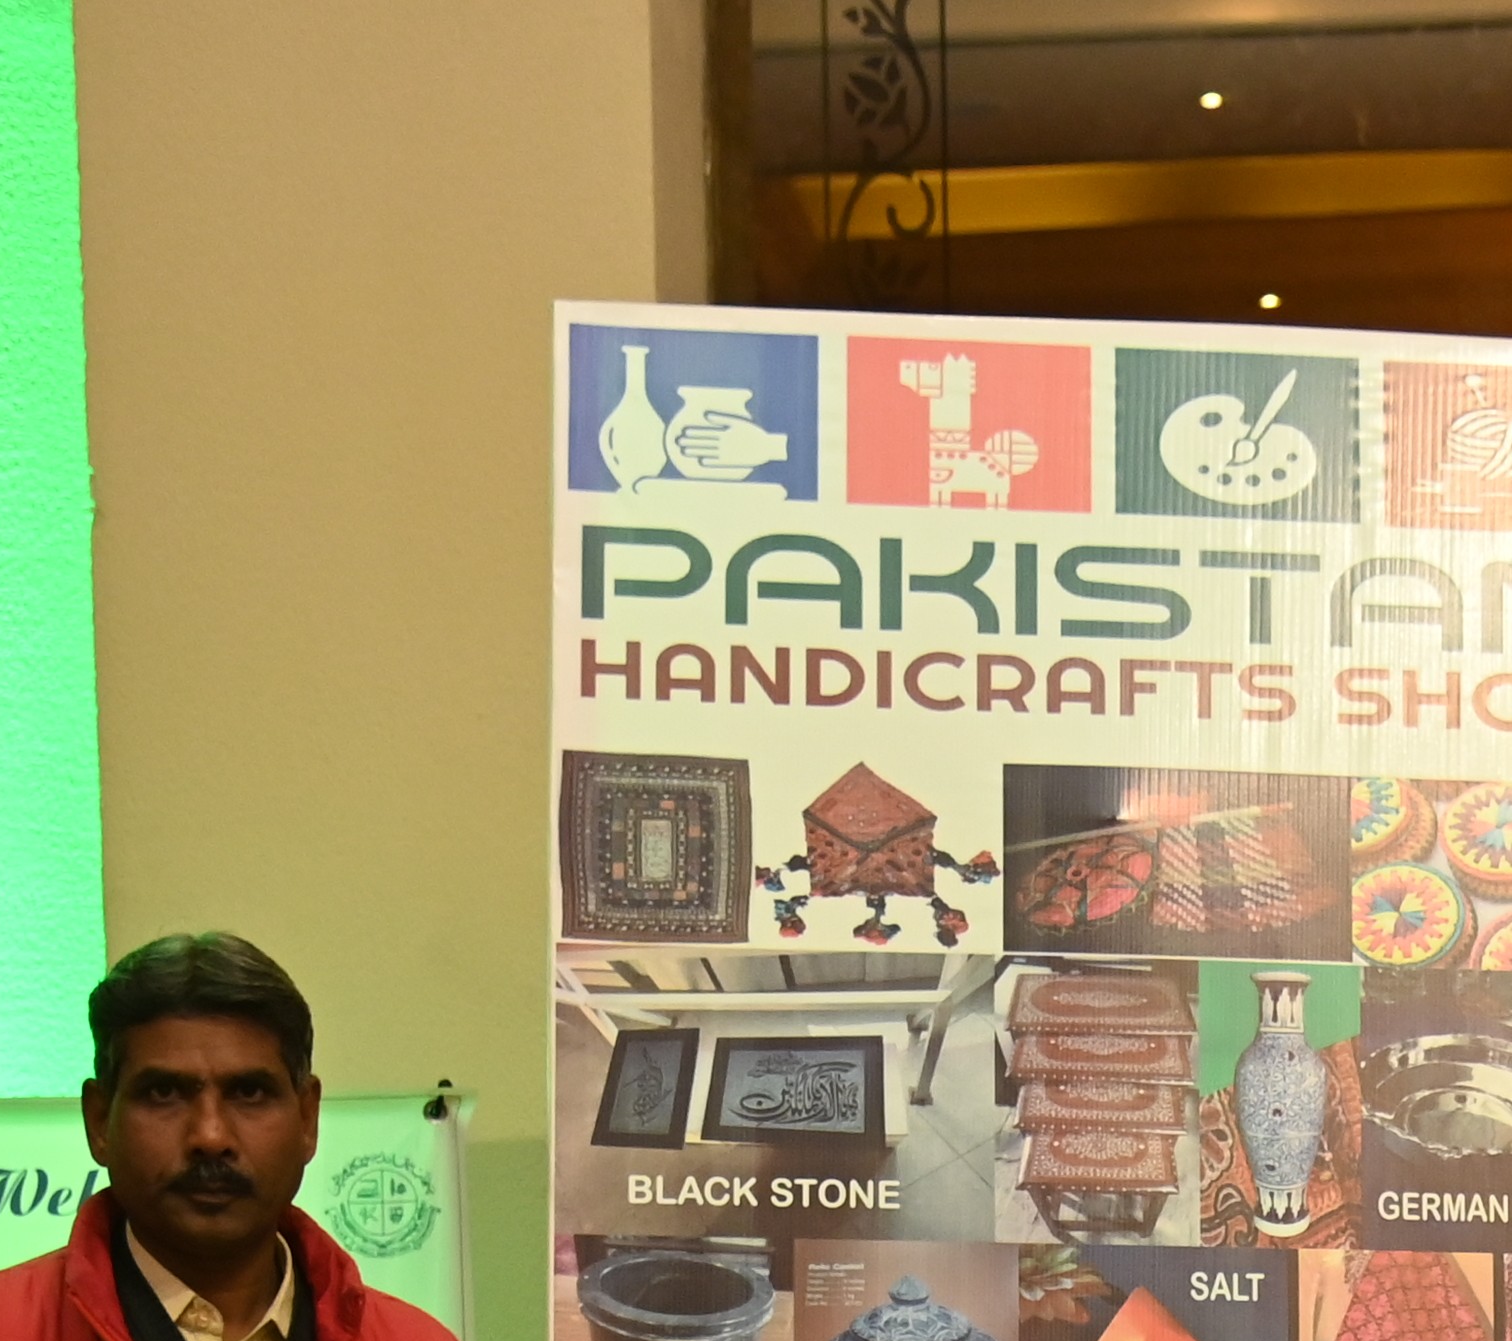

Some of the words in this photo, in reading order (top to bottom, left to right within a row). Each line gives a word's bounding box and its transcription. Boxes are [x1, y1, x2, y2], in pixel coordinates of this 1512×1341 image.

[581, 639, 1295, 721] HANDICRAFTS
[628, 1174, 760, 1207] BLACK
[771, 1173, 905, 1209] STONE
[1378, 1191, 1508, 1223] GERMAN
[1191, 1272, 1264, 1301] SALT
